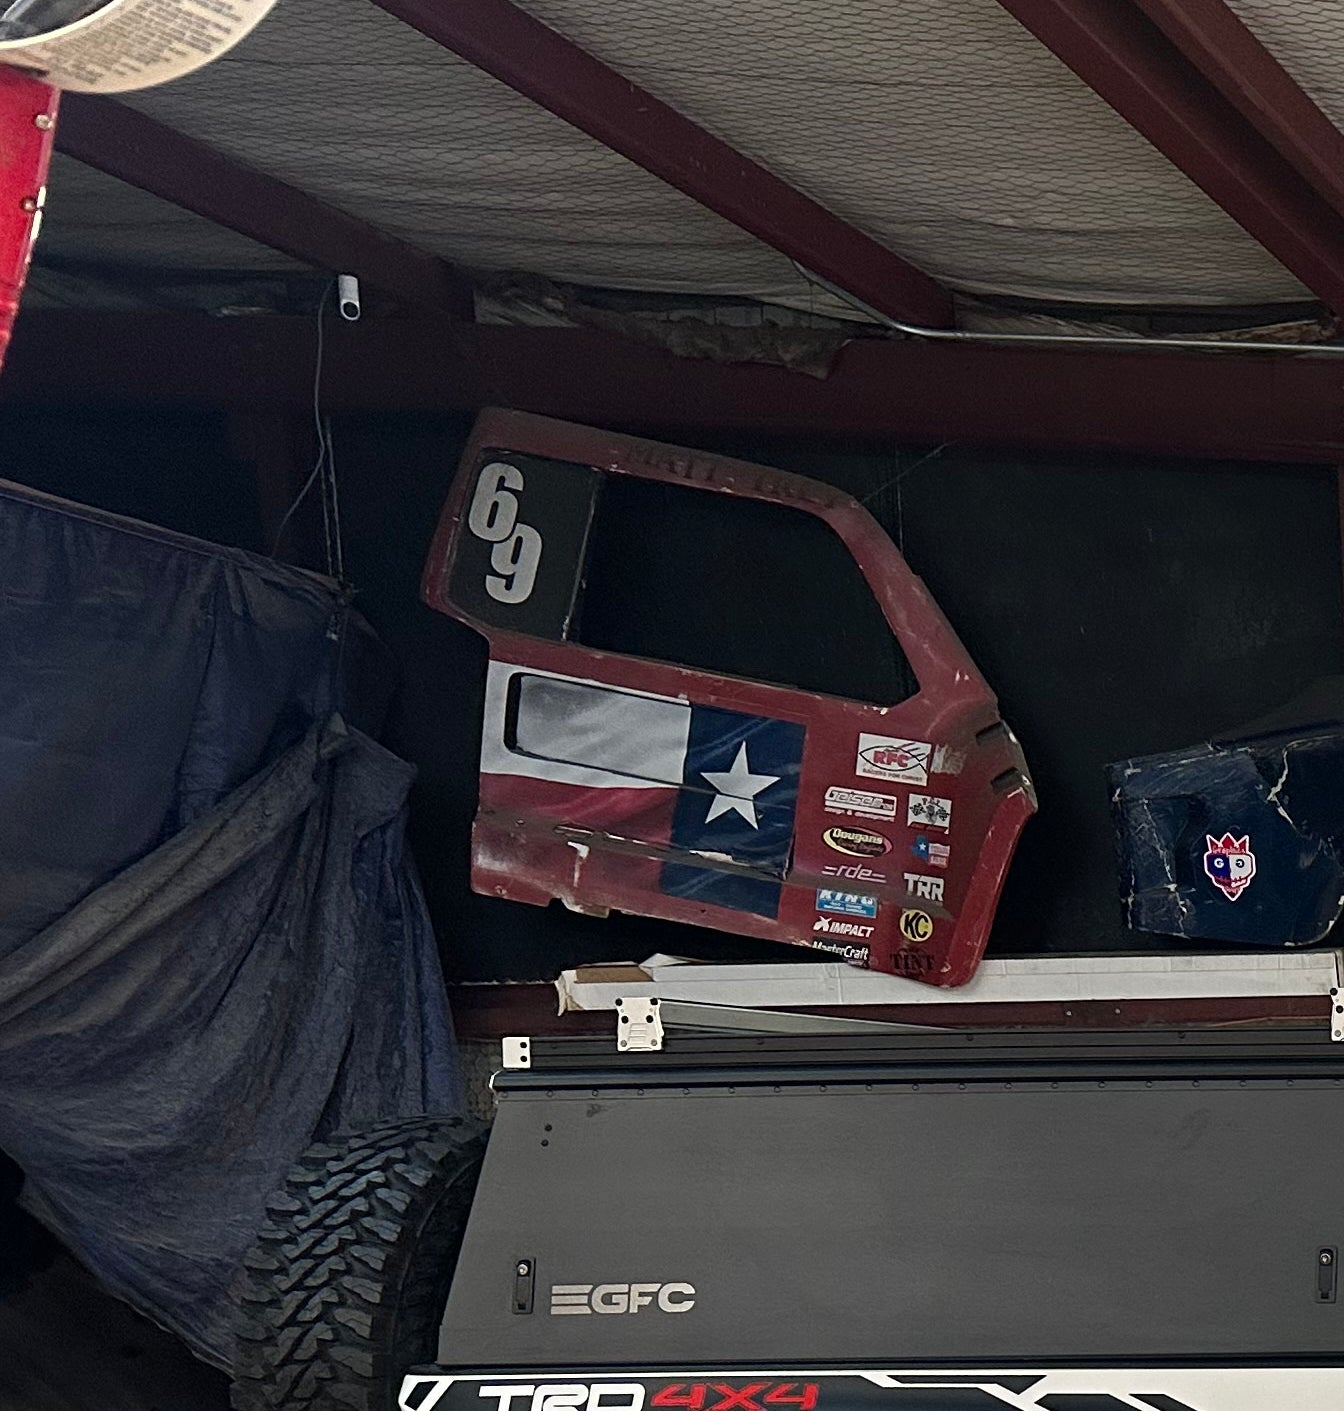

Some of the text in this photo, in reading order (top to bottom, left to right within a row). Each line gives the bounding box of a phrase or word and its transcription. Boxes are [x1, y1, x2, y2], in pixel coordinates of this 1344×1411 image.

[468, 461, 543, 604] 69
[872, 750, 908, 768] RFC
[832, 827, 883, 845] Dougans
[830, 921, 874, 938] IMPACT
[903, 912, 930, 940] KC
[650, 1381, 820, 1411] 4X4
